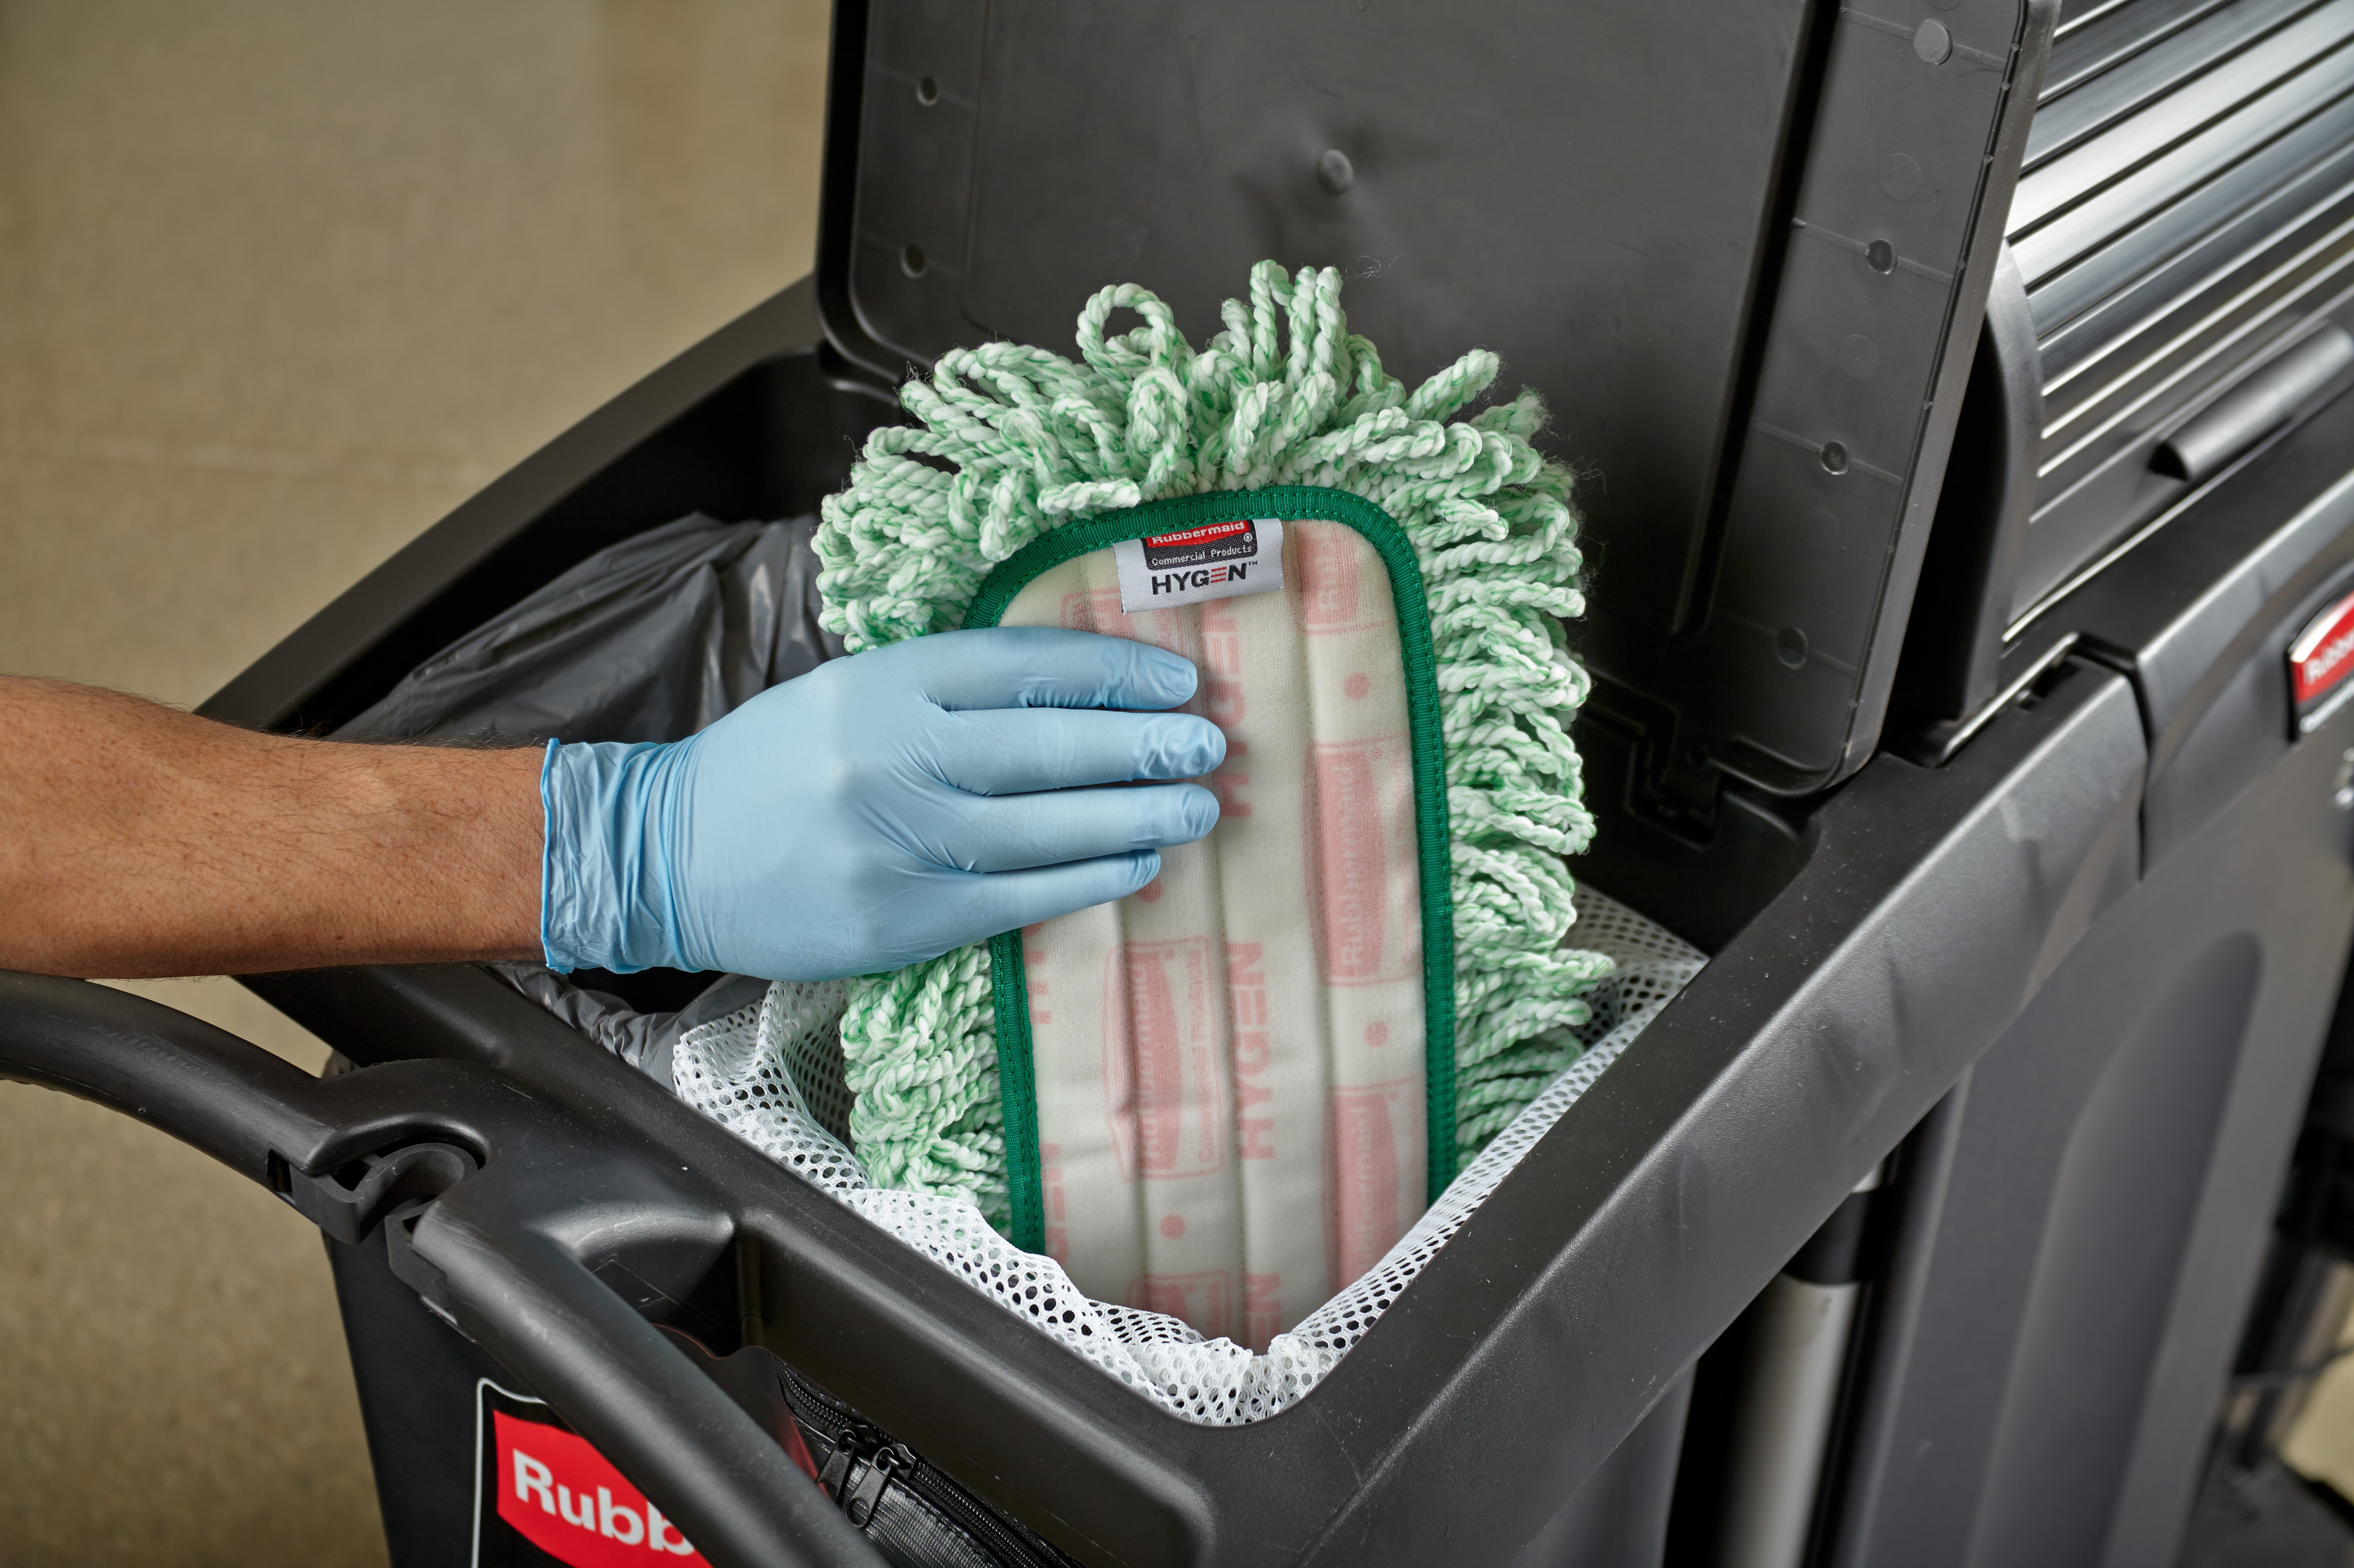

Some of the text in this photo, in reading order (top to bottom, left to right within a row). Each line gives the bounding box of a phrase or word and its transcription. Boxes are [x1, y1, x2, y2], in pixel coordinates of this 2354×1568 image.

[1152, 521, 1245, 544] Rubbermaid
[1151, 544, 1252, 567] Commercial Products
